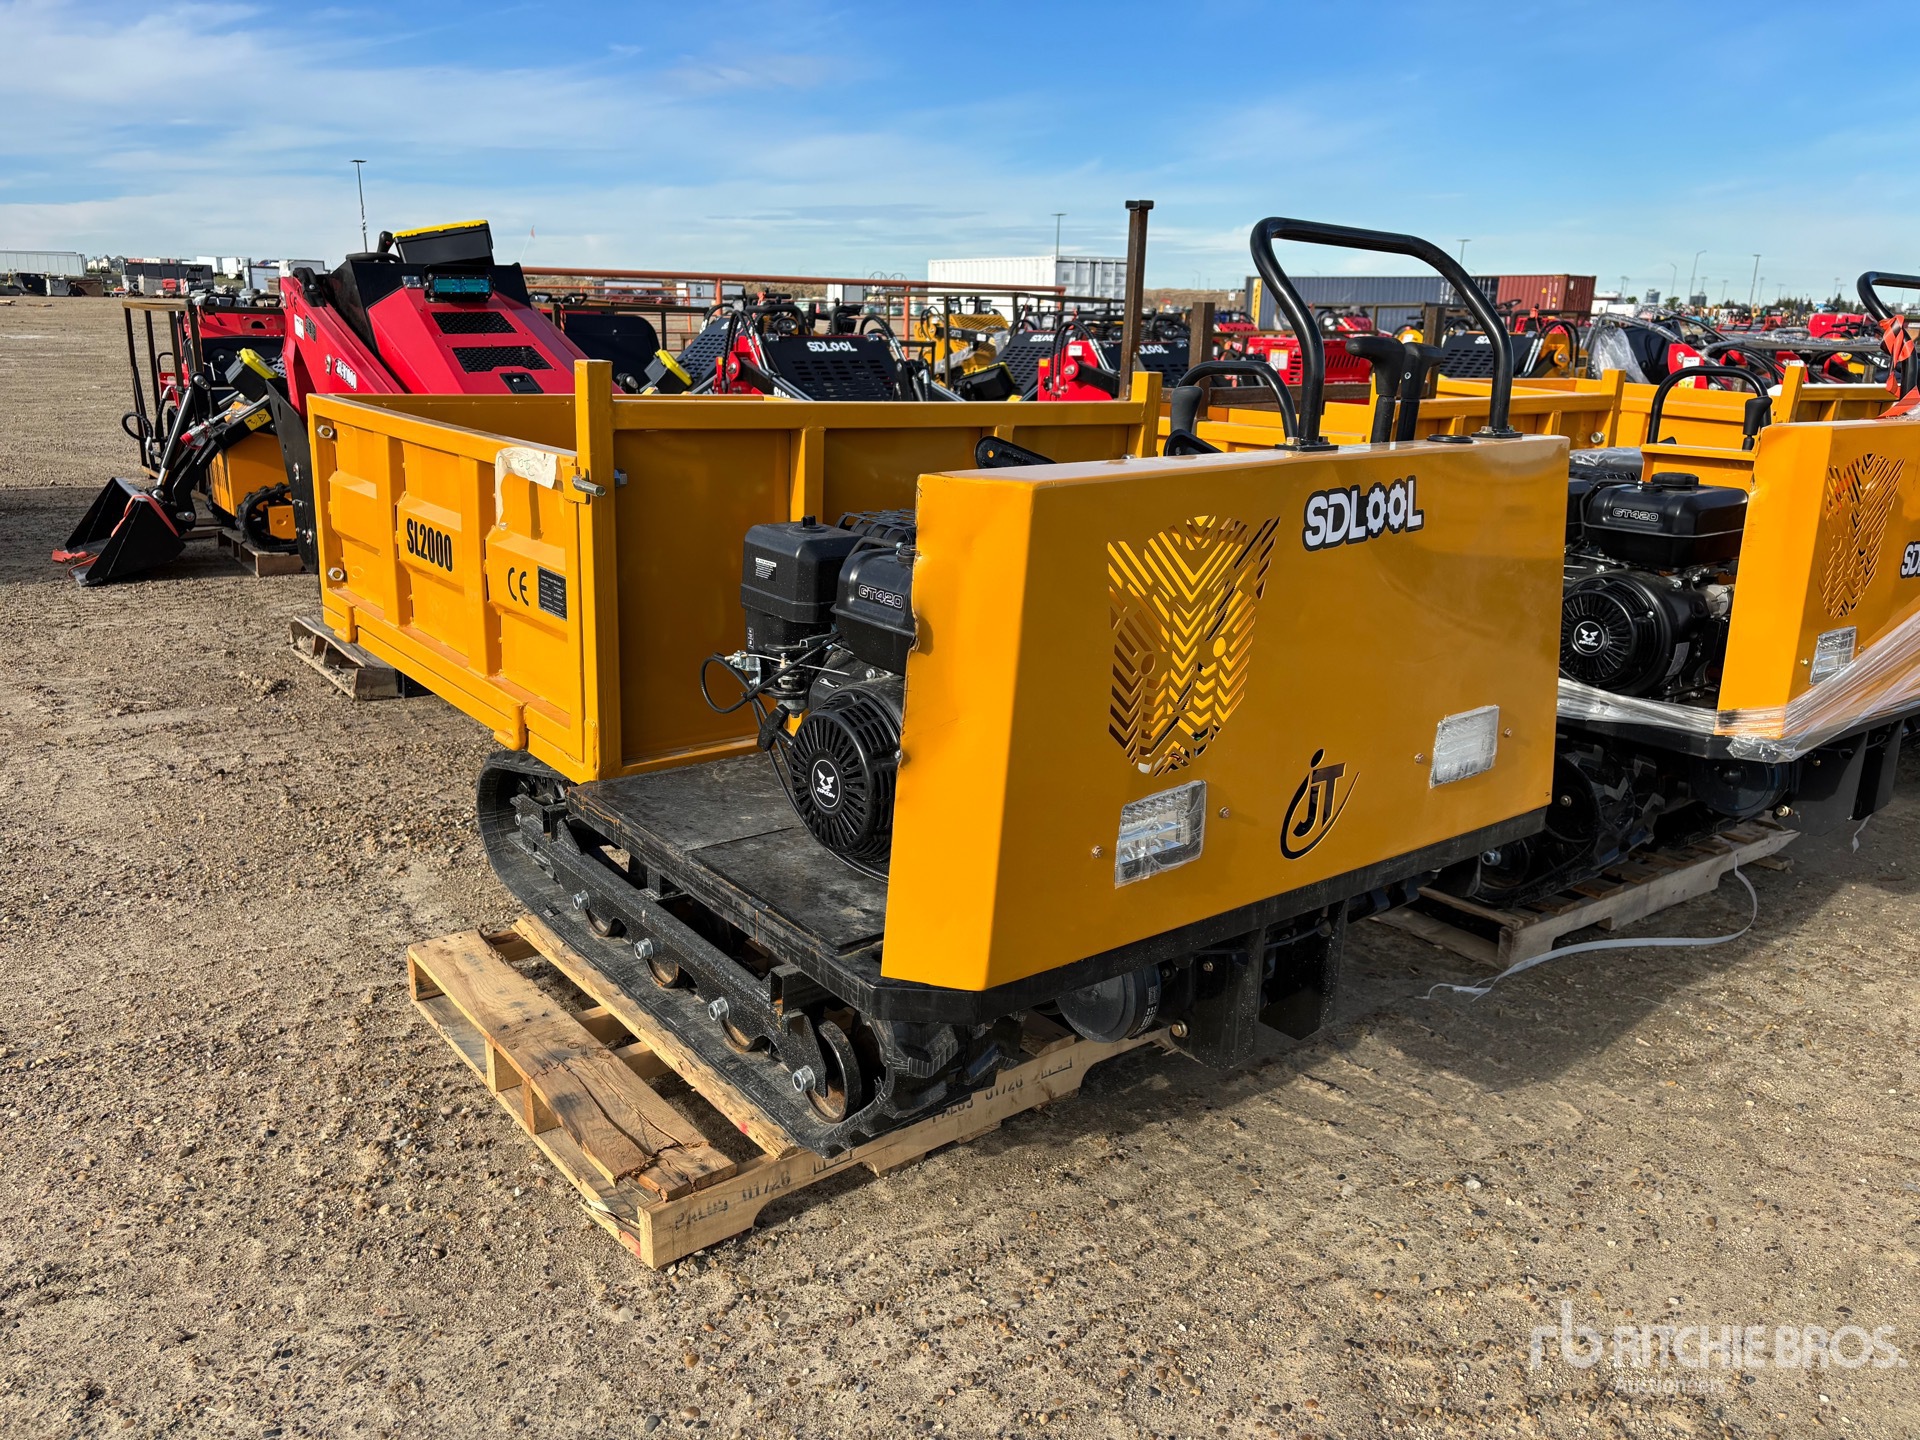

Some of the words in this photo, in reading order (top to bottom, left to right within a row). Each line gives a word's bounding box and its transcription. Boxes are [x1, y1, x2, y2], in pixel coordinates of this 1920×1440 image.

[807, 341, 858, 352] SDLOOL
[1303, 477, 1423, 549] SDLOOL
[1612, 507, 1659, 522] GT420
[406, 518, 453, 572] SL2000
[507, 567, 530, 607] CE
[858, 584, 904, 609] GT420
